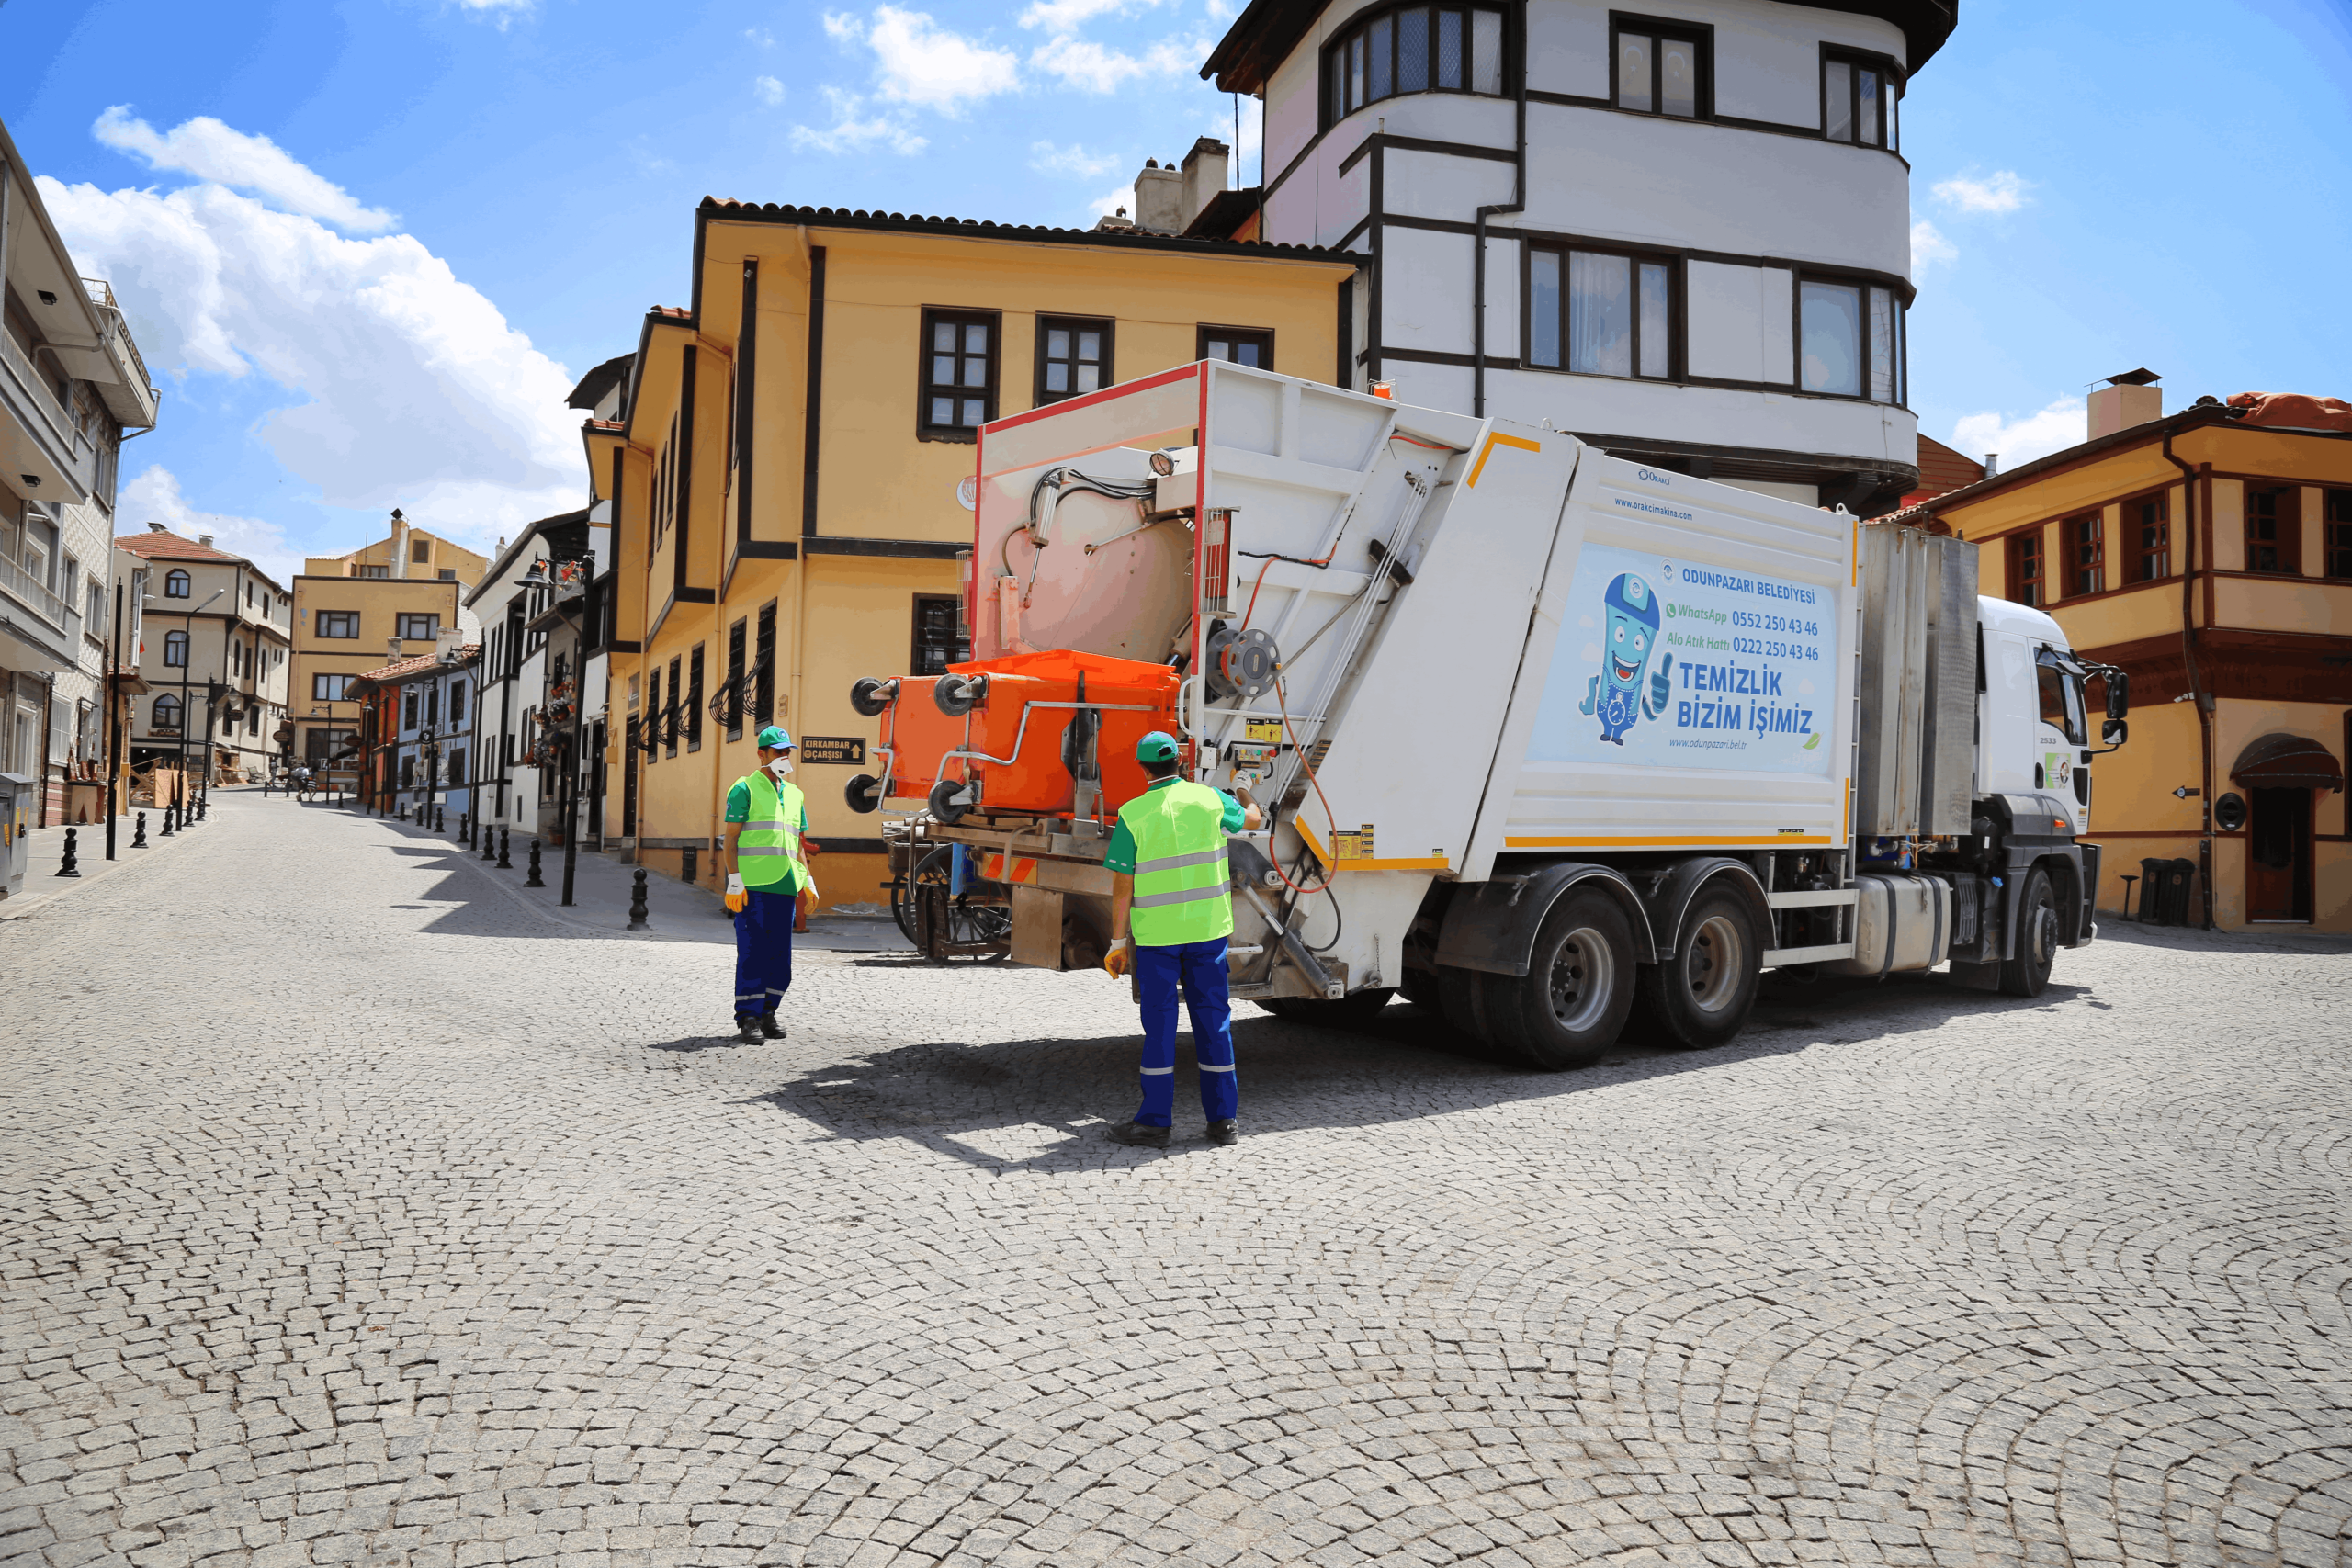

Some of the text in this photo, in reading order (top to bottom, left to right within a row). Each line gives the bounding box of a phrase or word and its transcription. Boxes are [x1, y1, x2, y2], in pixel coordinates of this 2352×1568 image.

[1615, 498, 1692, 521] www.orakcimakina.com
[1682, 568, 1815, 604] ODUNPAZARI BELEDİYESİ
[1679, 604, 1818, 637] WhatsApp 0552 250 43 46
[1667, 632, 1818, 661] Alo Atık Hattı 0222 250 43 46
[1679, 660, 1782, 696] TEMİZLİK
[1677, 694, 1813, 740] BİZİM İŞİMİZ
[805, 740, 850, 749] KIRKAMBAR
[812, 750, 842, 760] ÇARŞISI
[1669, 738, 1747, 750] www.odunpazari.bel.tr
